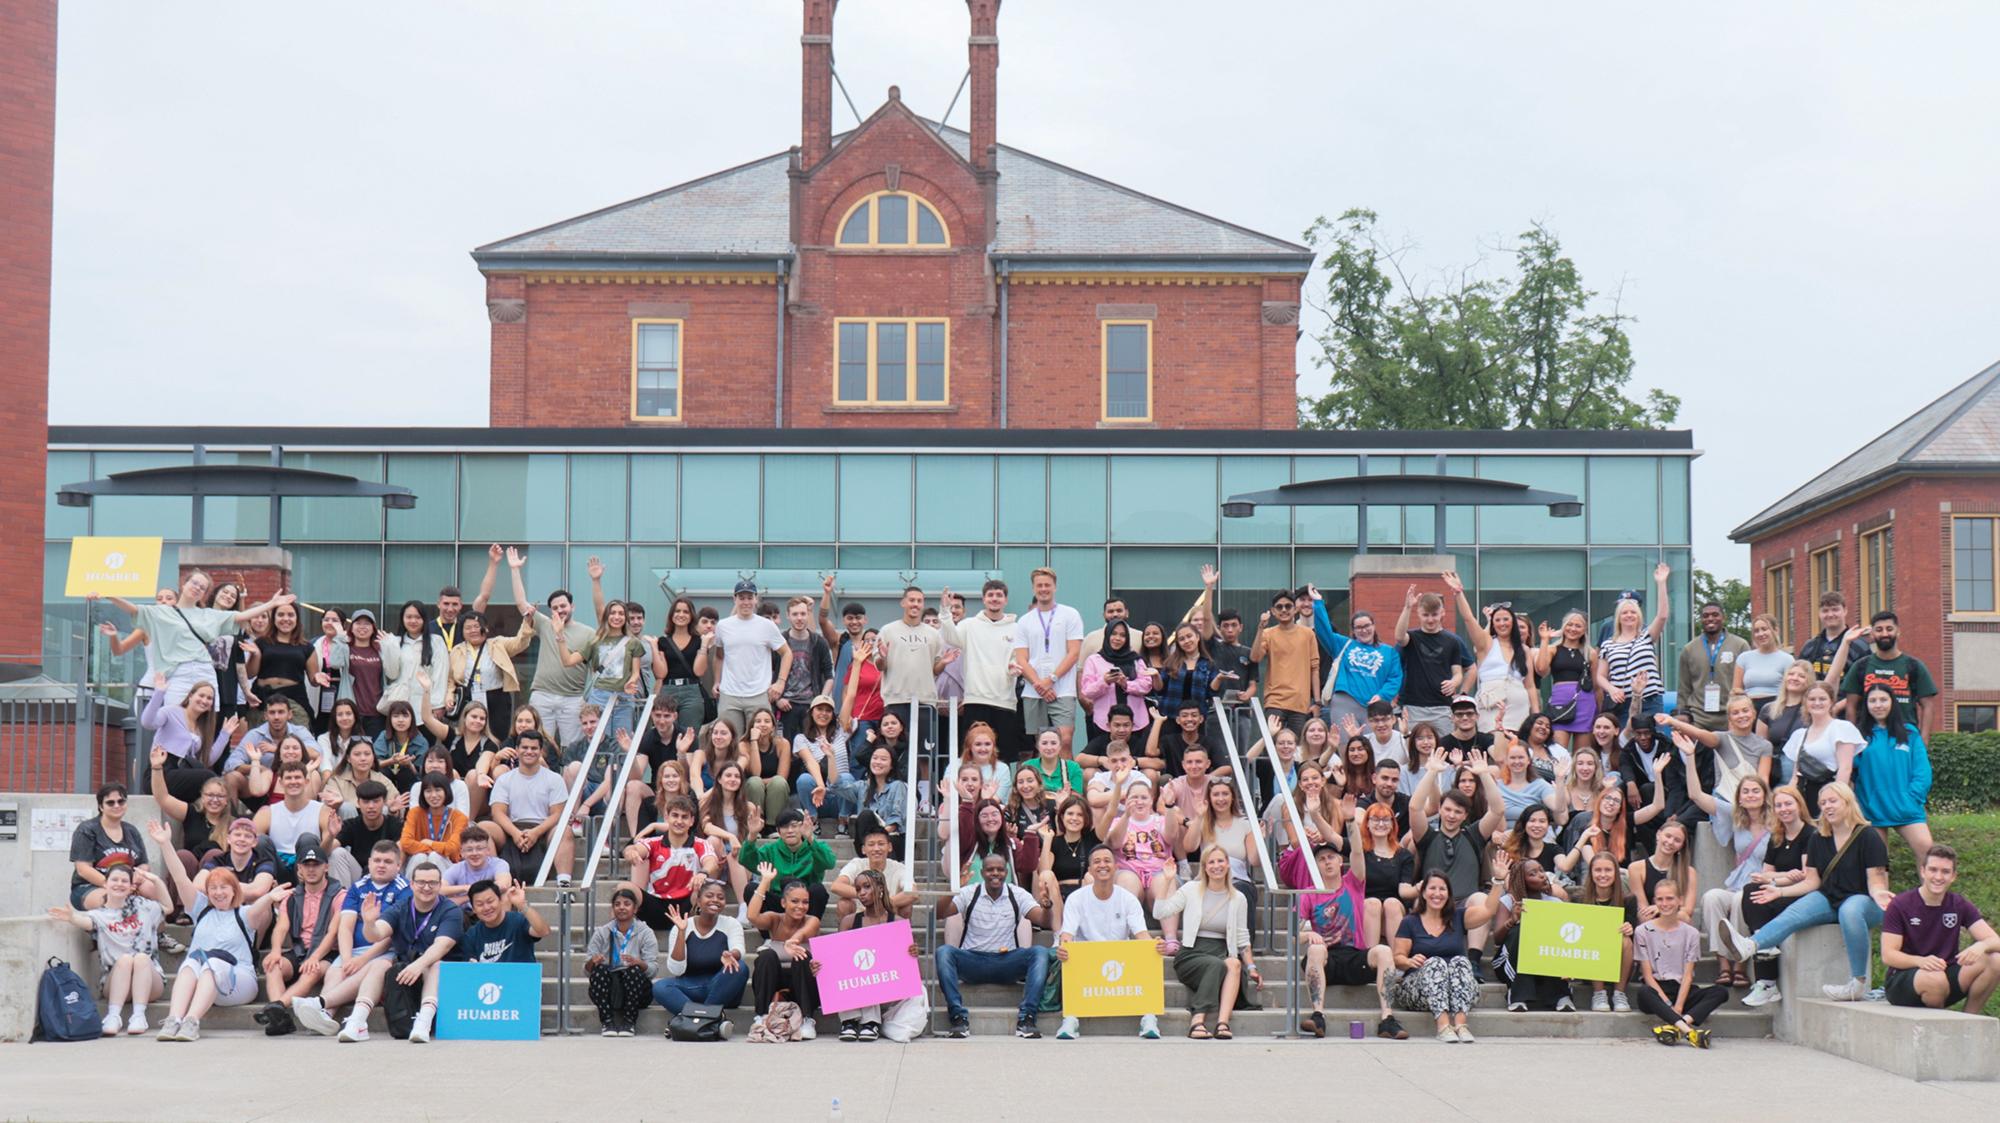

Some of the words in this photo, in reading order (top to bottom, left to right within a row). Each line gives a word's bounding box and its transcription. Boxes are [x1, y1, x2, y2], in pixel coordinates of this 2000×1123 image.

[483, 939, 506, 957] NIKE
[1538, 944, 1600, 960] HUMBER
[837, 970, 900, 992] HUMBER
[1082, 985, 1144, 998] HUMBER
[457, 1009, 520, 1021] HUMBER
